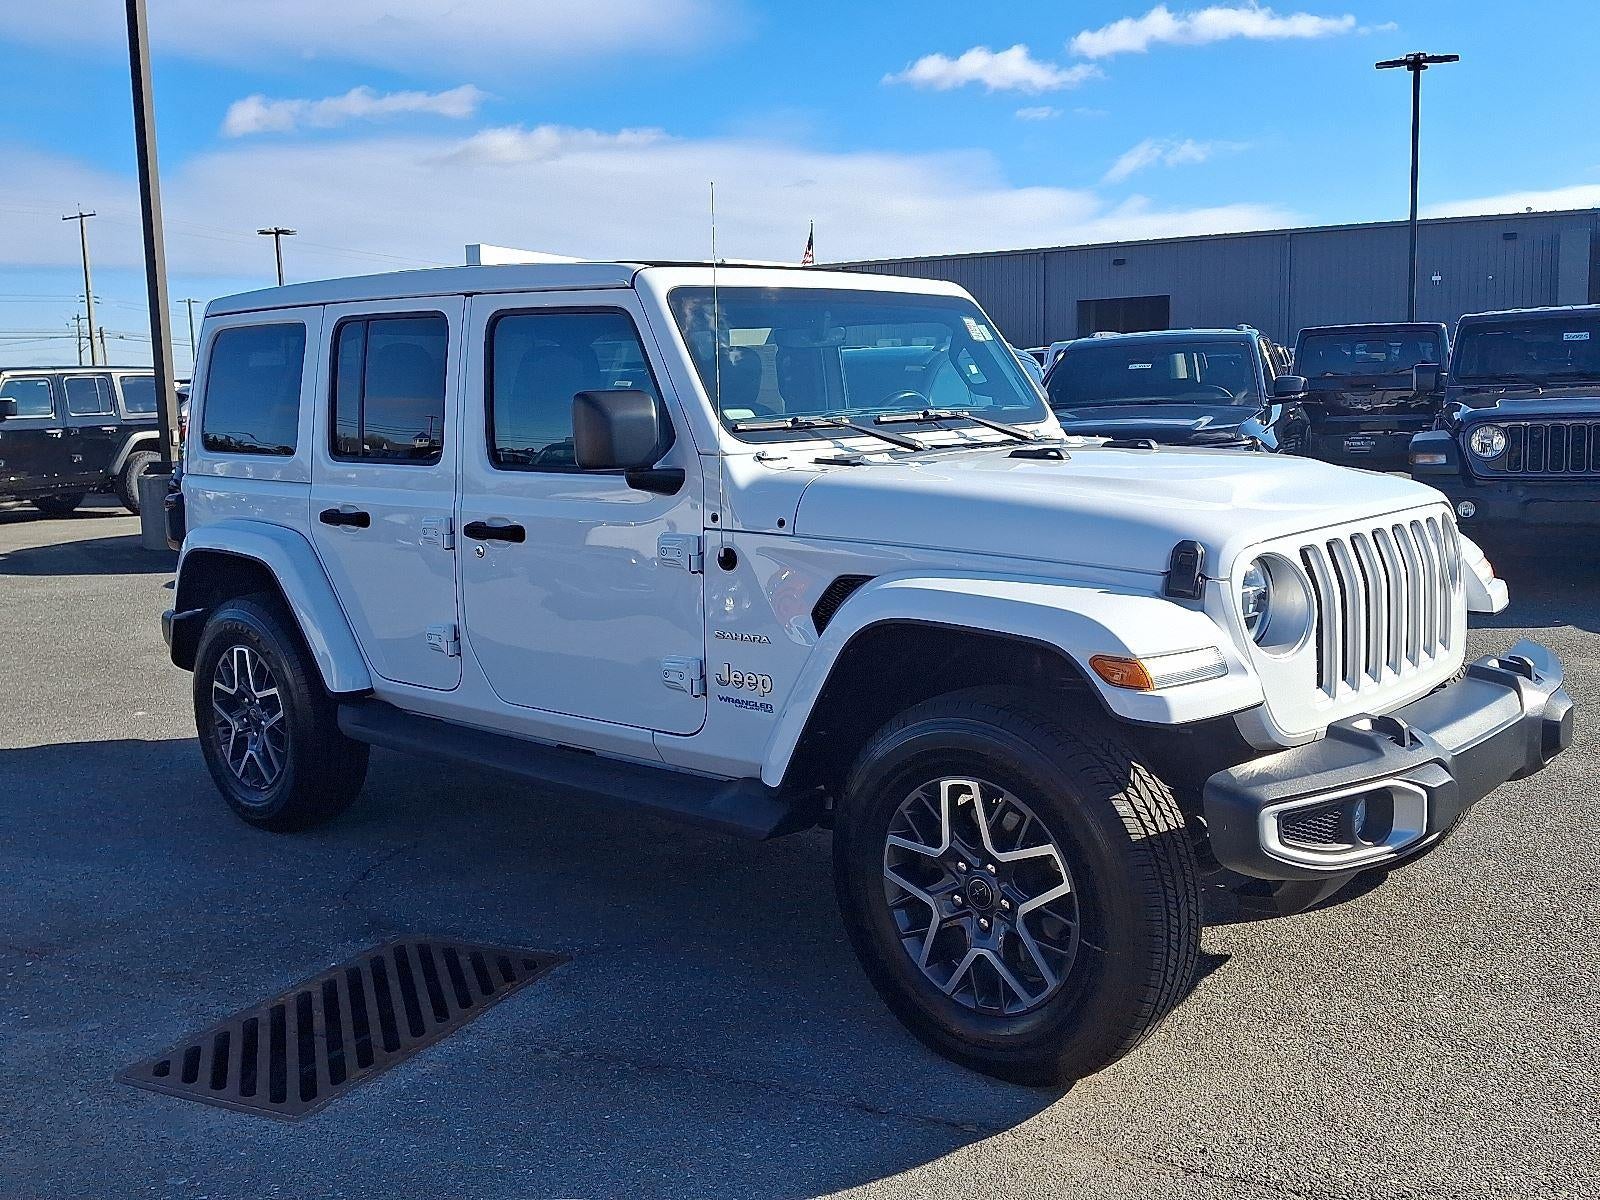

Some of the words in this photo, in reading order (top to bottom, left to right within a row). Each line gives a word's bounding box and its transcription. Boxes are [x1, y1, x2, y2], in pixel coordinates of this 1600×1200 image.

[714, 630, 771, 644] SAHARA
[715, 662, 773, 697] Jeep
[717, 695, 774, 710] WRANGLER
[735, 703, 774, 713] UNLIMITED
